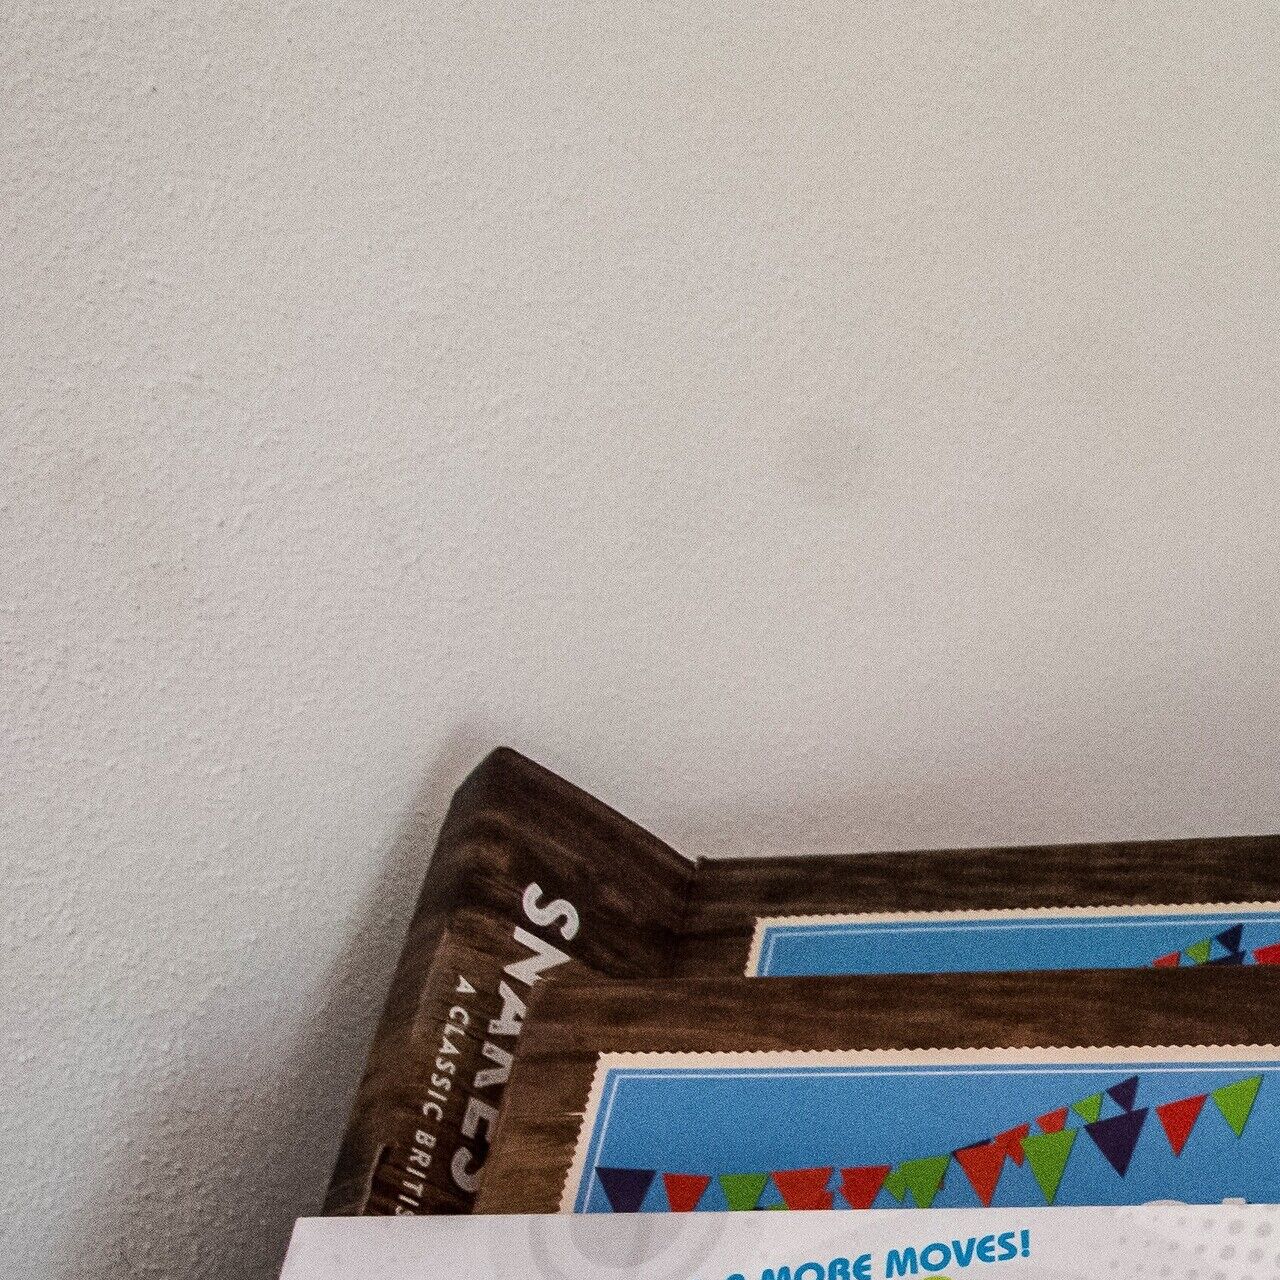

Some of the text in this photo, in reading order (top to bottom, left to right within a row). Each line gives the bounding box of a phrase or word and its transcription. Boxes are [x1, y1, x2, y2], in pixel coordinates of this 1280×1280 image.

[395, 974, 477, 1215] A CLASSIC BRITIS
[884, 1229, 1030, 1279] MOVES!
